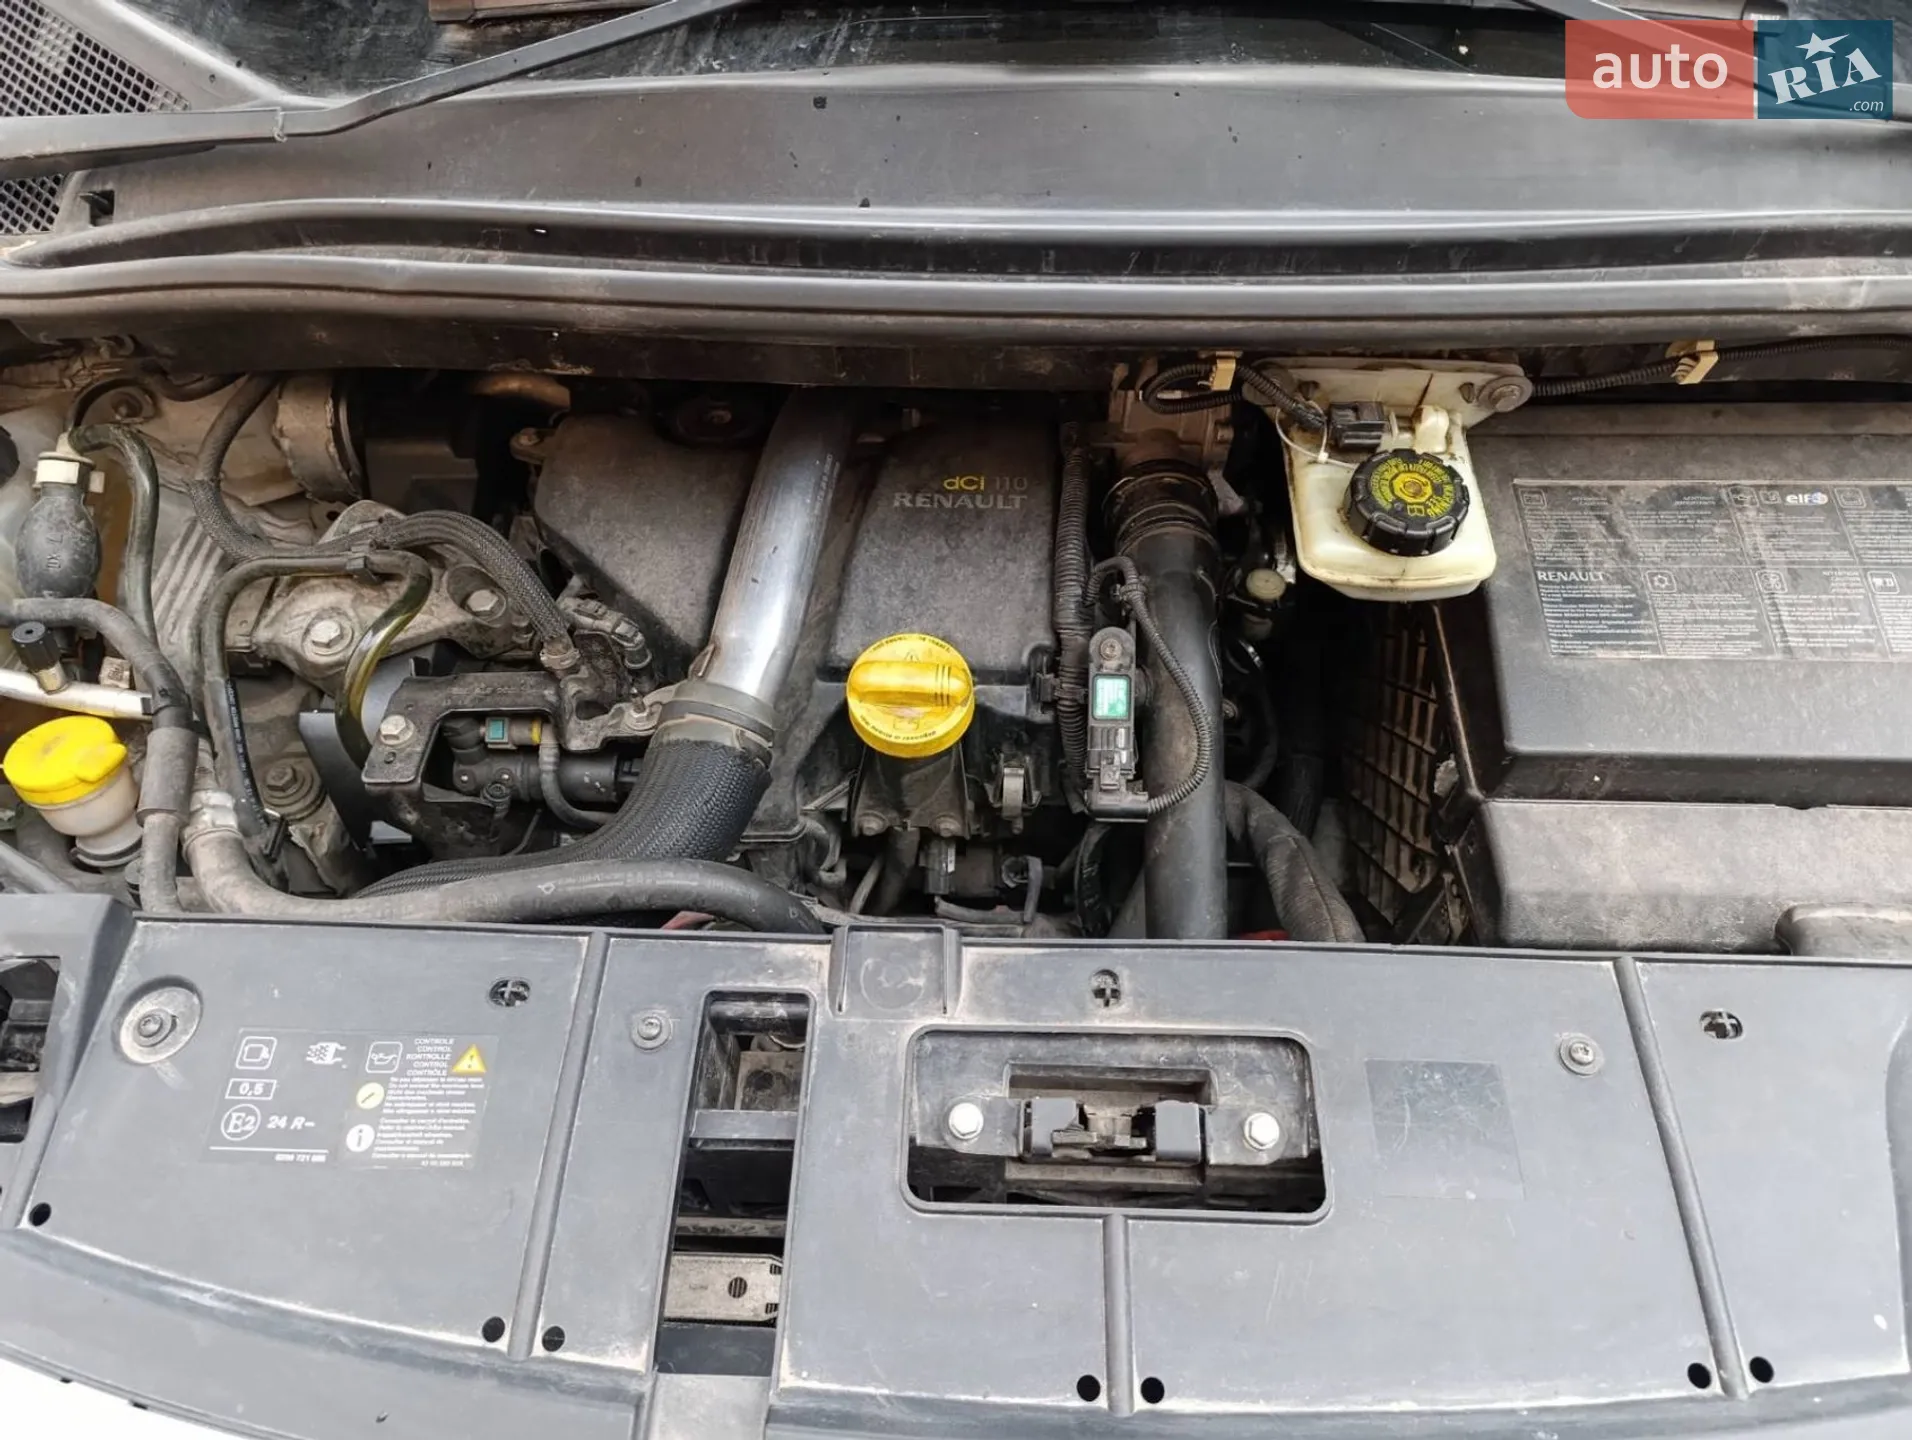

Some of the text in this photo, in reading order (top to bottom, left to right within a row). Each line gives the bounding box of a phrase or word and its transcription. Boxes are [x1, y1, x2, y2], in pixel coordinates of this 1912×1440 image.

[893, 491, 1028, 509] RENAULT
[1536, 570, 1604, 582] RENAULT
[239, 1081, 265, 1096] 0,5
[226, 1111, 257, 1134] E2
[266, 1115, 289, 1129] 24
